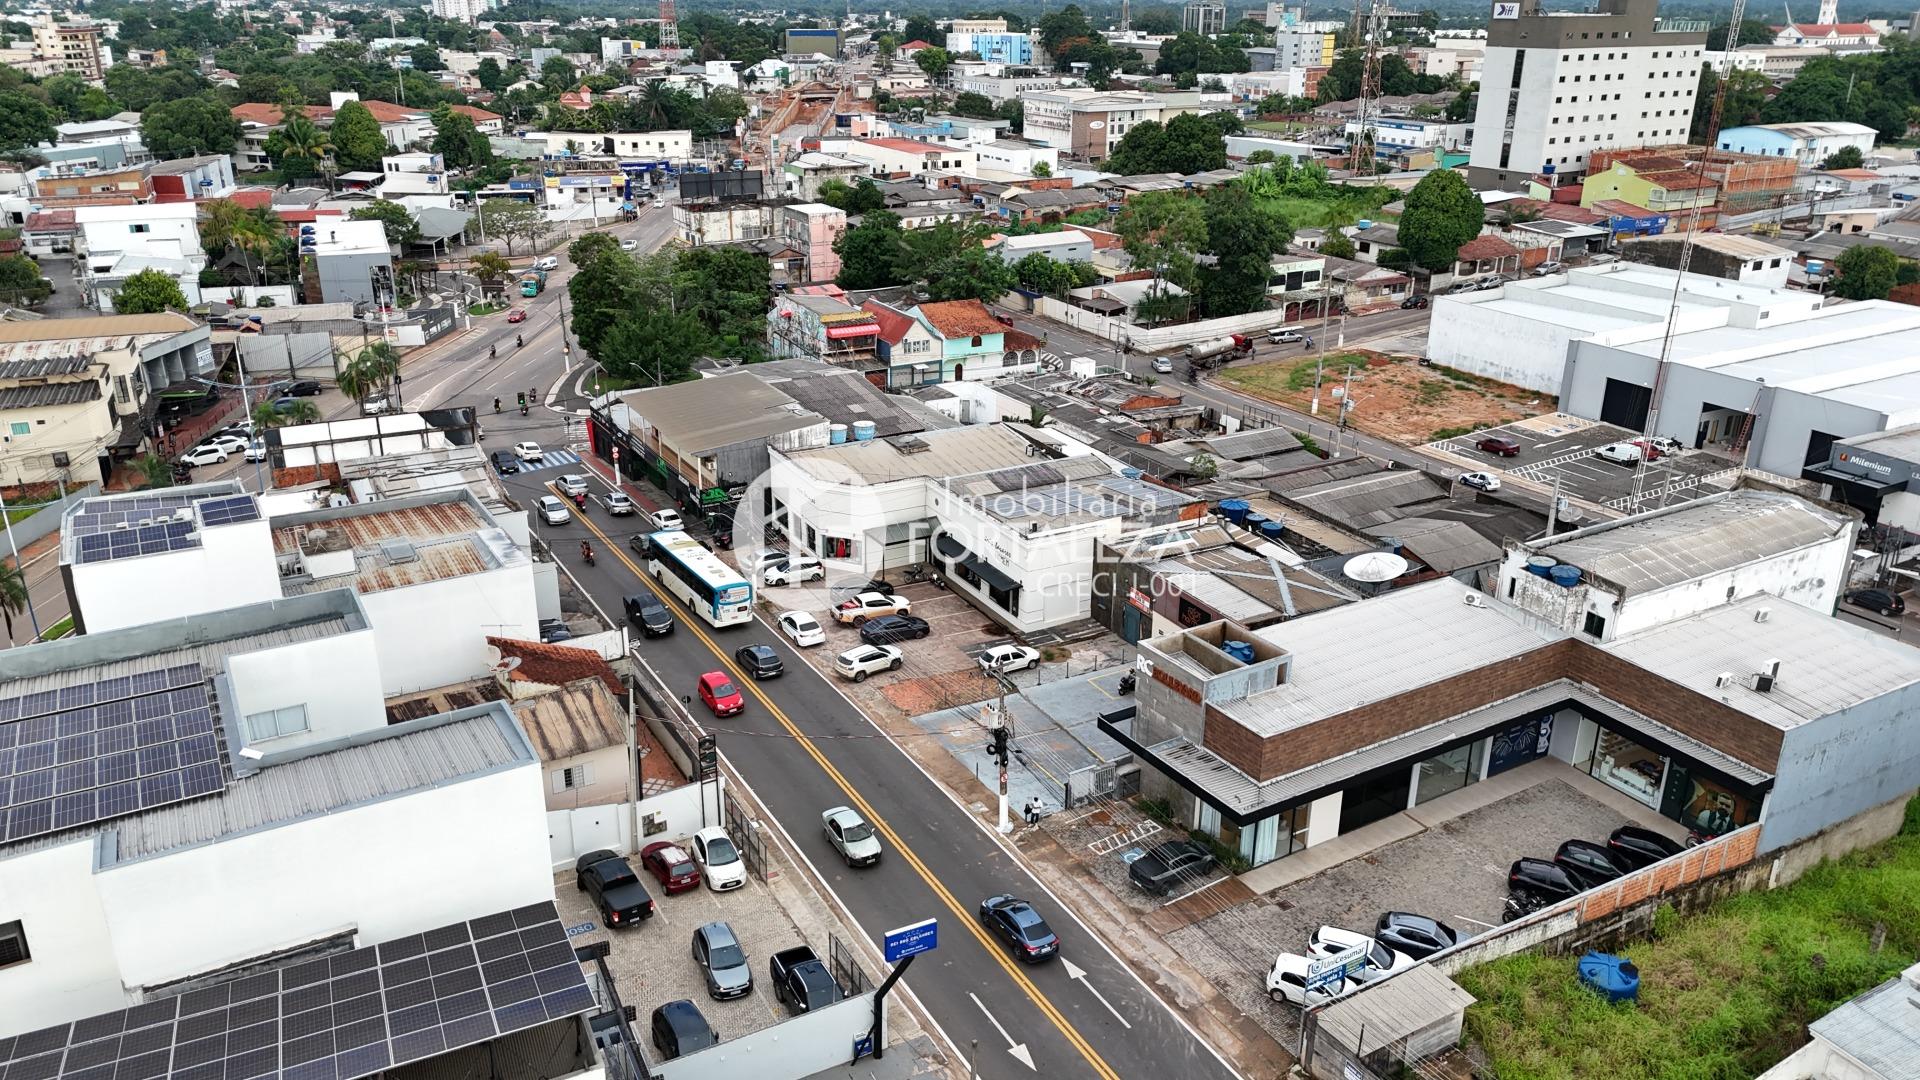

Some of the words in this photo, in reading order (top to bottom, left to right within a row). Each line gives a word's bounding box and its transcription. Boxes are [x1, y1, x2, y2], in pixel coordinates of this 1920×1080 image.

[1850, 456, 1891, 473] Milenium
[1136, 653, 1154, 677] RC
[566, 924, 592, 935] OSO
[1323, 947, 1364, 969] UniCesumar
